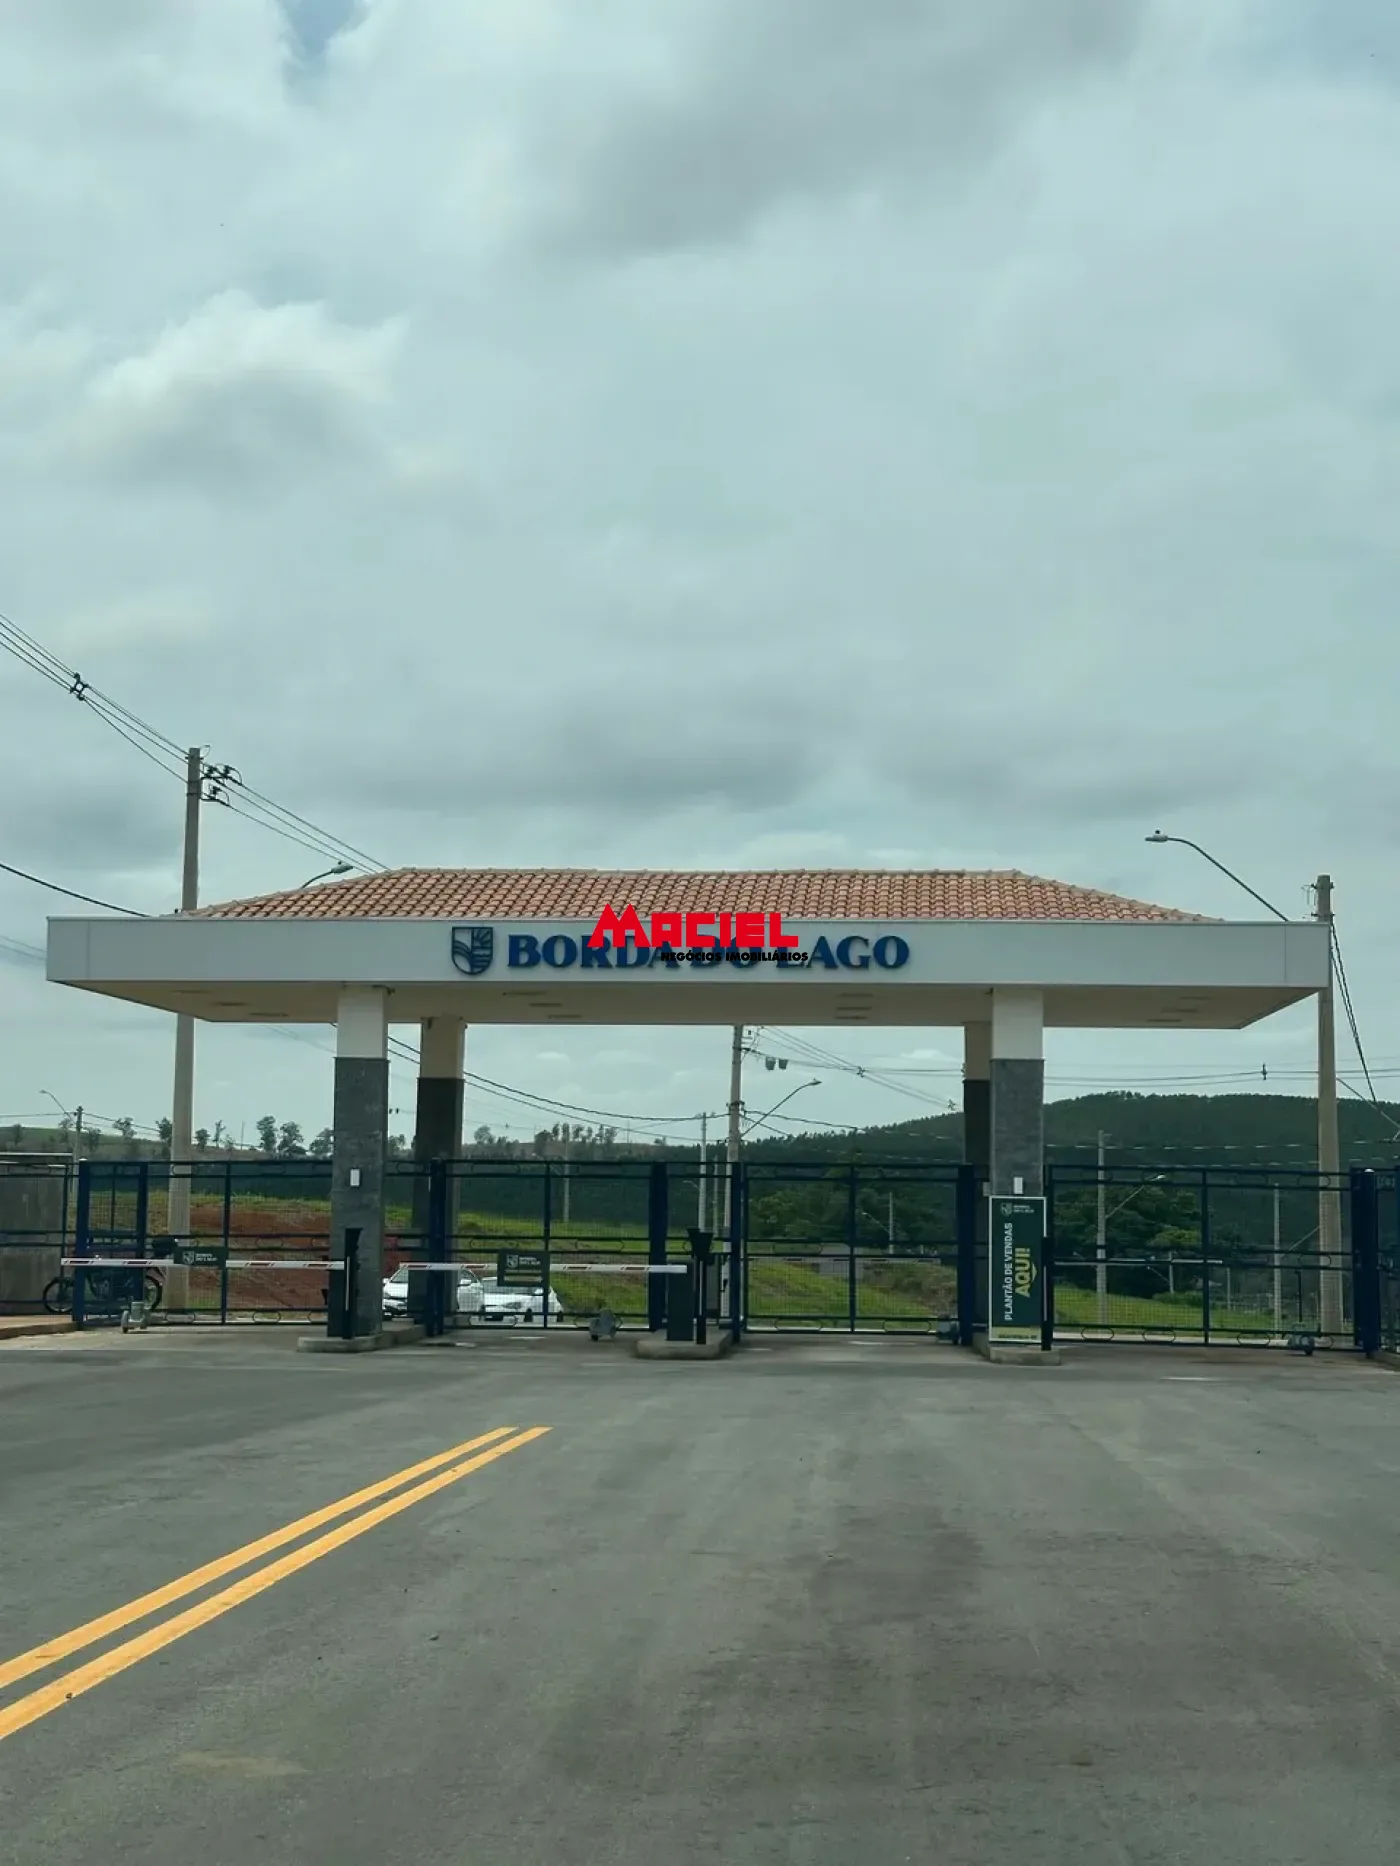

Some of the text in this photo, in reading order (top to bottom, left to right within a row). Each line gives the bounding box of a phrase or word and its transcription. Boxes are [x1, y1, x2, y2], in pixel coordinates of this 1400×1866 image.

[507, 934, 680, 968] BORDA
[1002, 1222, 1013, 1321] PLANTÃO DE VENDAS
[1015, 1247, 1031, 1298] AQUI!
